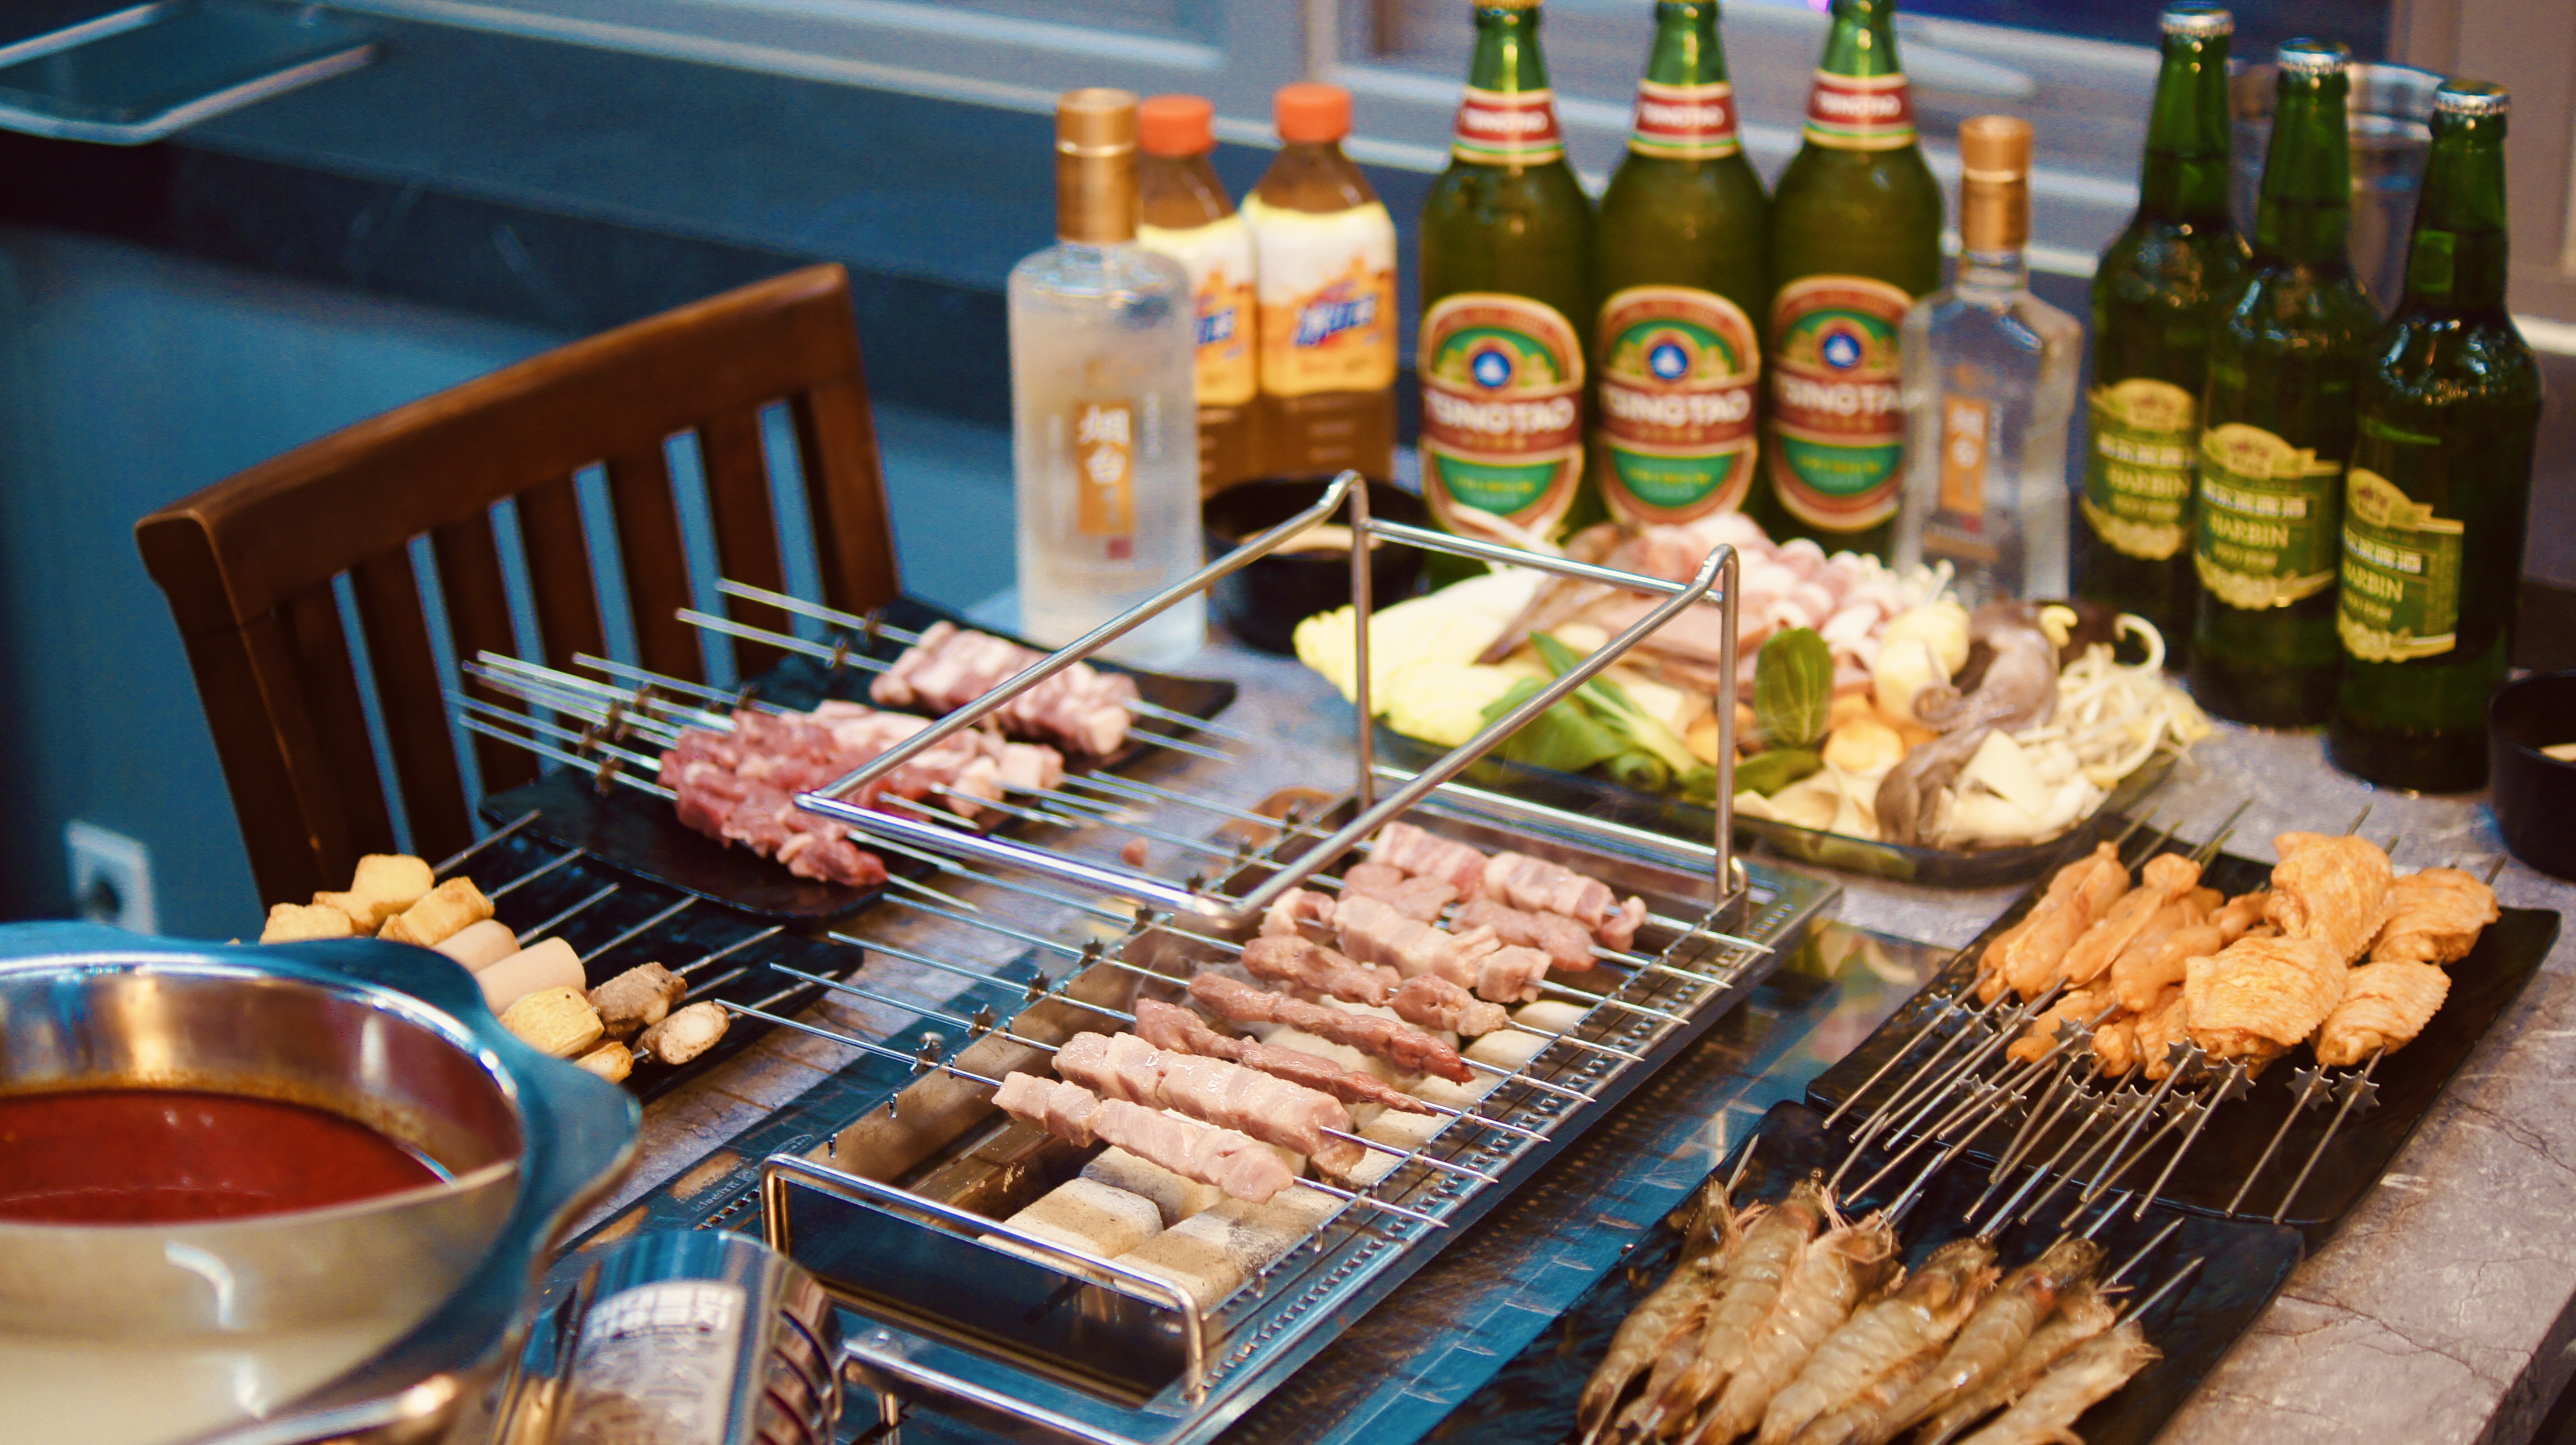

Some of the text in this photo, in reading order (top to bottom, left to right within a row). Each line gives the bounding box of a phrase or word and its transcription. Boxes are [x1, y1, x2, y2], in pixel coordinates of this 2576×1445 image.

[1424, 389, 1576, 434] TSINGTAO
[1599, 382, 1751, 427] TSINGTAO
[2107, 464, 2191, 498] HARBIN
[2209, 511, 2290, 549] HARBIN
